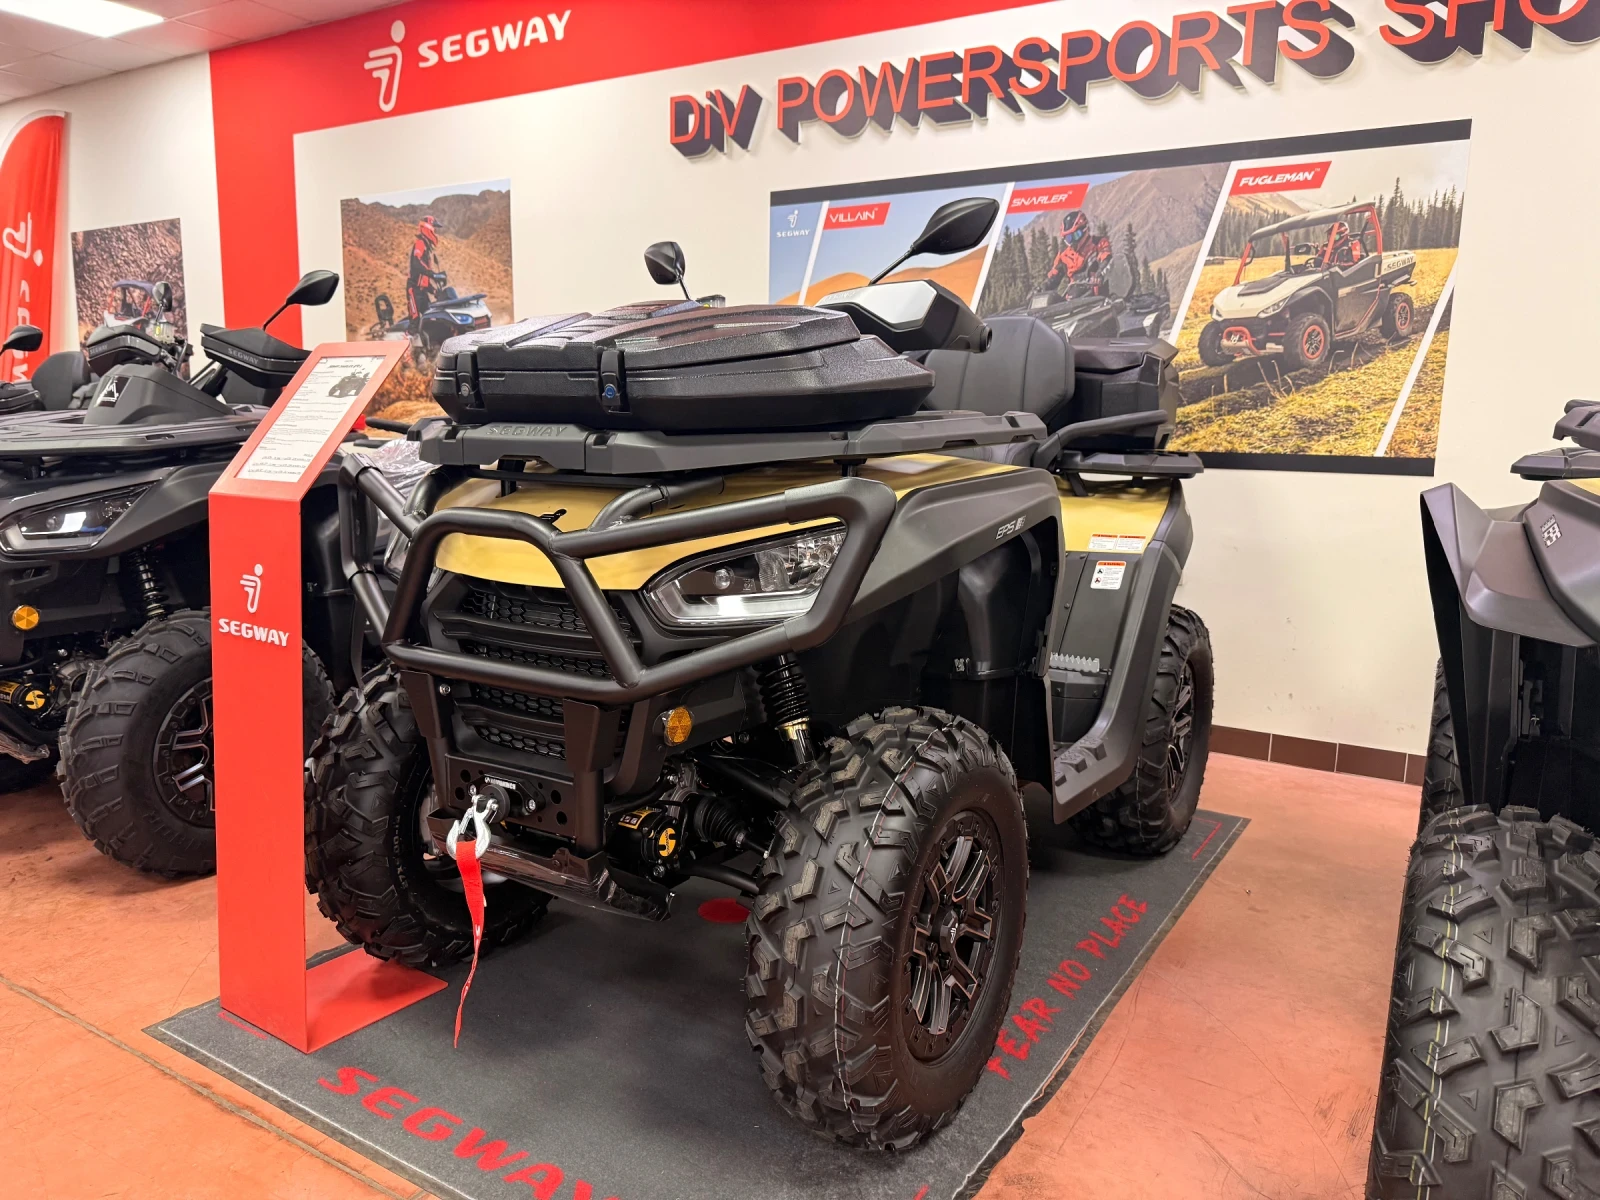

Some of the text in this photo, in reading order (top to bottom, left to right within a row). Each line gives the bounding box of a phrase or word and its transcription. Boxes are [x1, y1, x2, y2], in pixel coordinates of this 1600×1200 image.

[418, 9, 572, 68] SEGWAY
[669, 84, 752, 146] DiV
[777, 0, 1333, 130] POWERSPORTS
[1238, 171, 1315, 187] FUGLEMAN
[1011, 193, 1069, 207] SNARLER
[829, 211, 875, 223] VILLAIN
[776, 229, 811, 238] SEGWAY
[227, 347, 259, 365] SEGWAY
[486, 425, 568, 437] SEGWAY
[218, 618, 290, 647] SEGWAY
[1047, 959, 1092, 1000] NO
[1075, 893, 1148, 960] PLACE
